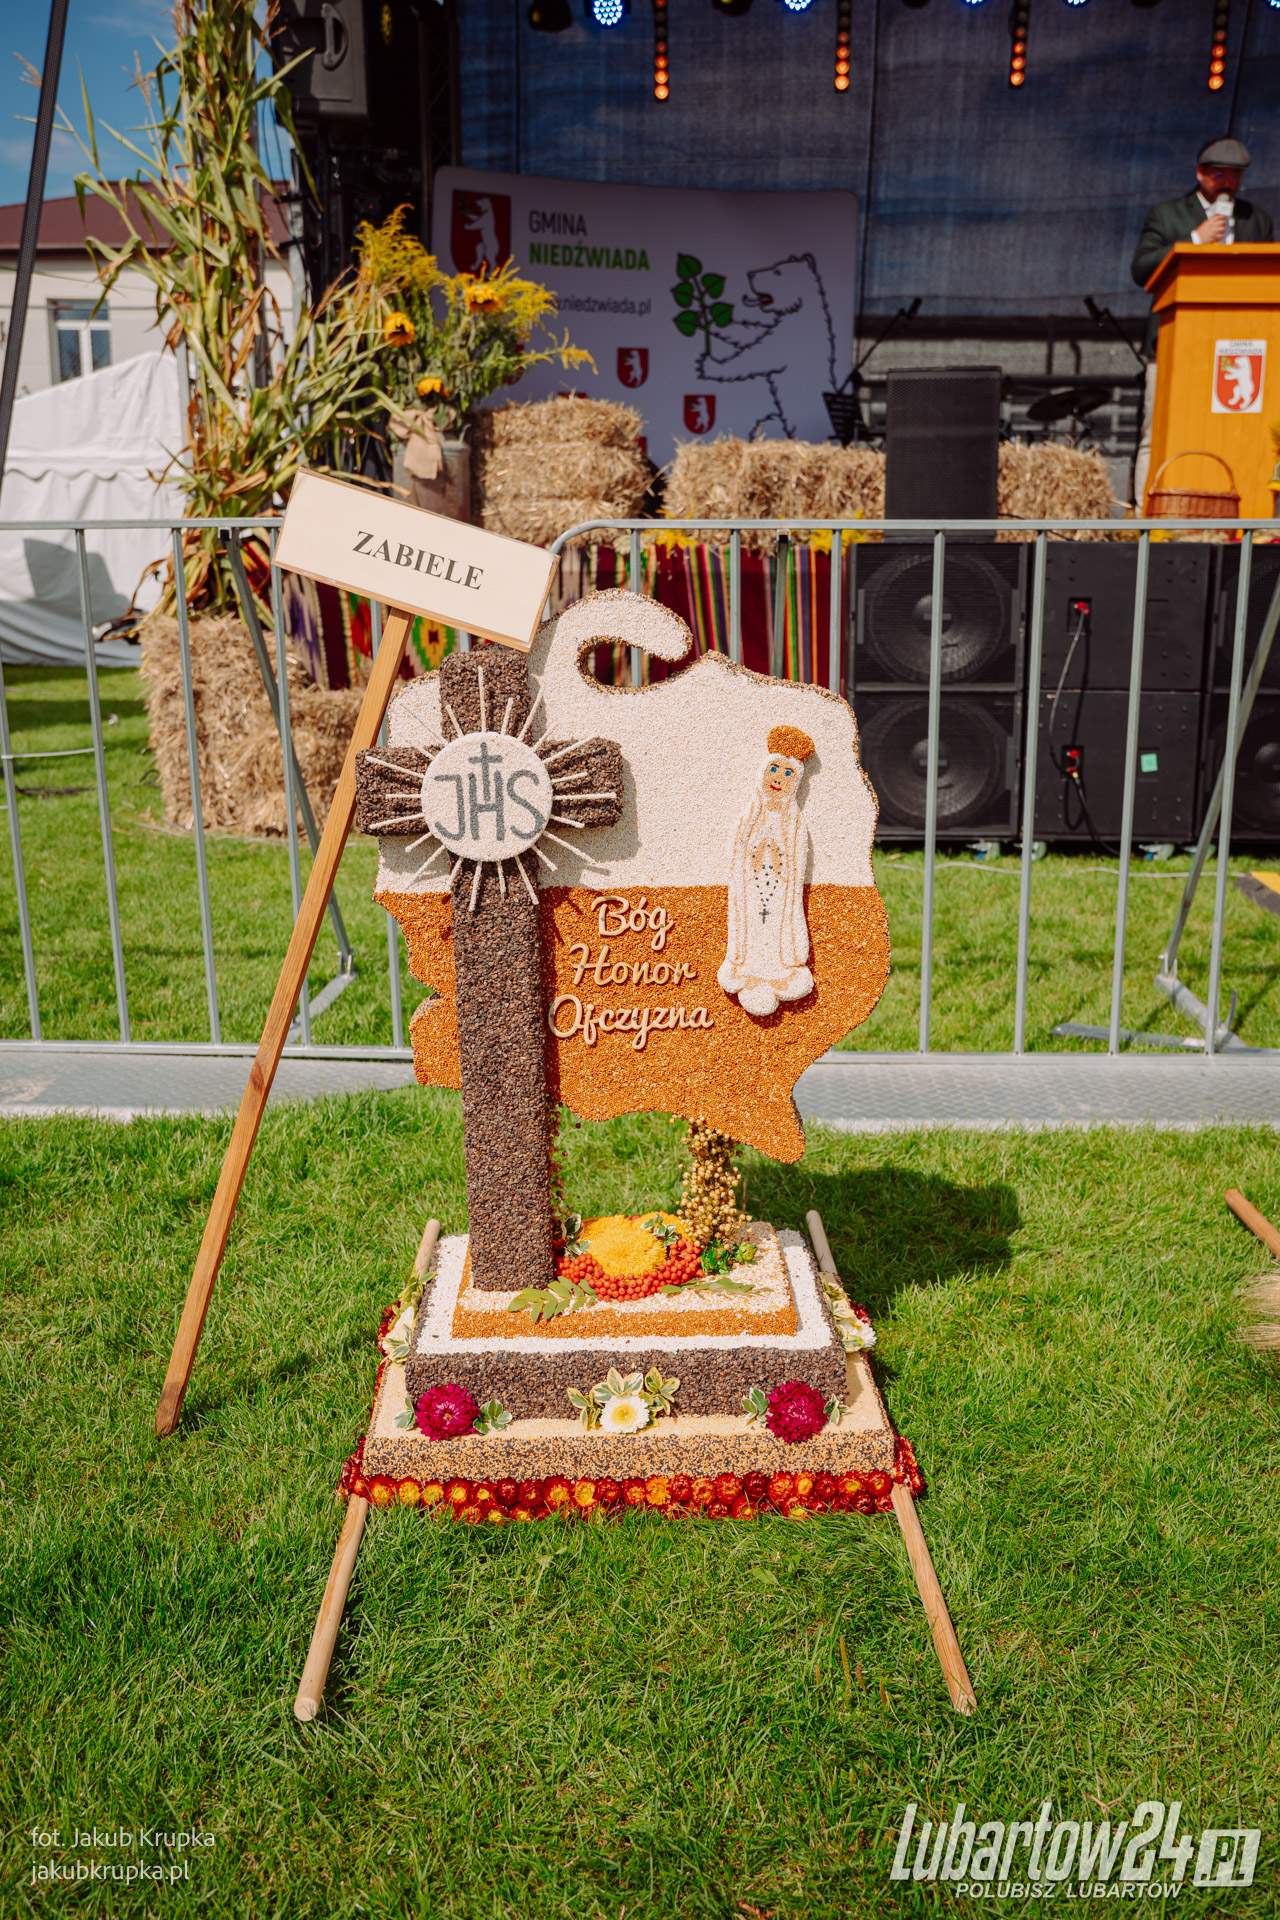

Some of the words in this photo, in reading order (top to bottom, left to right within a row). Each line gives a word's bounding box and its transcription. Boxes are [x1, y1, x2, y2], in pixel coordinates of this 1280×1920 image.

[528, 210, 587, 236] GMINA
[528, 240, 650, 271] NIEDŹWIADA
[352, 530, 484, 590] ZABIELE
[434, 769, 545, 841] JHS
[591, 895, 675, 950] Bóg
[569, 943, 697, 986] Honor
[548, 994, 714, 1050] Ojczyzna
